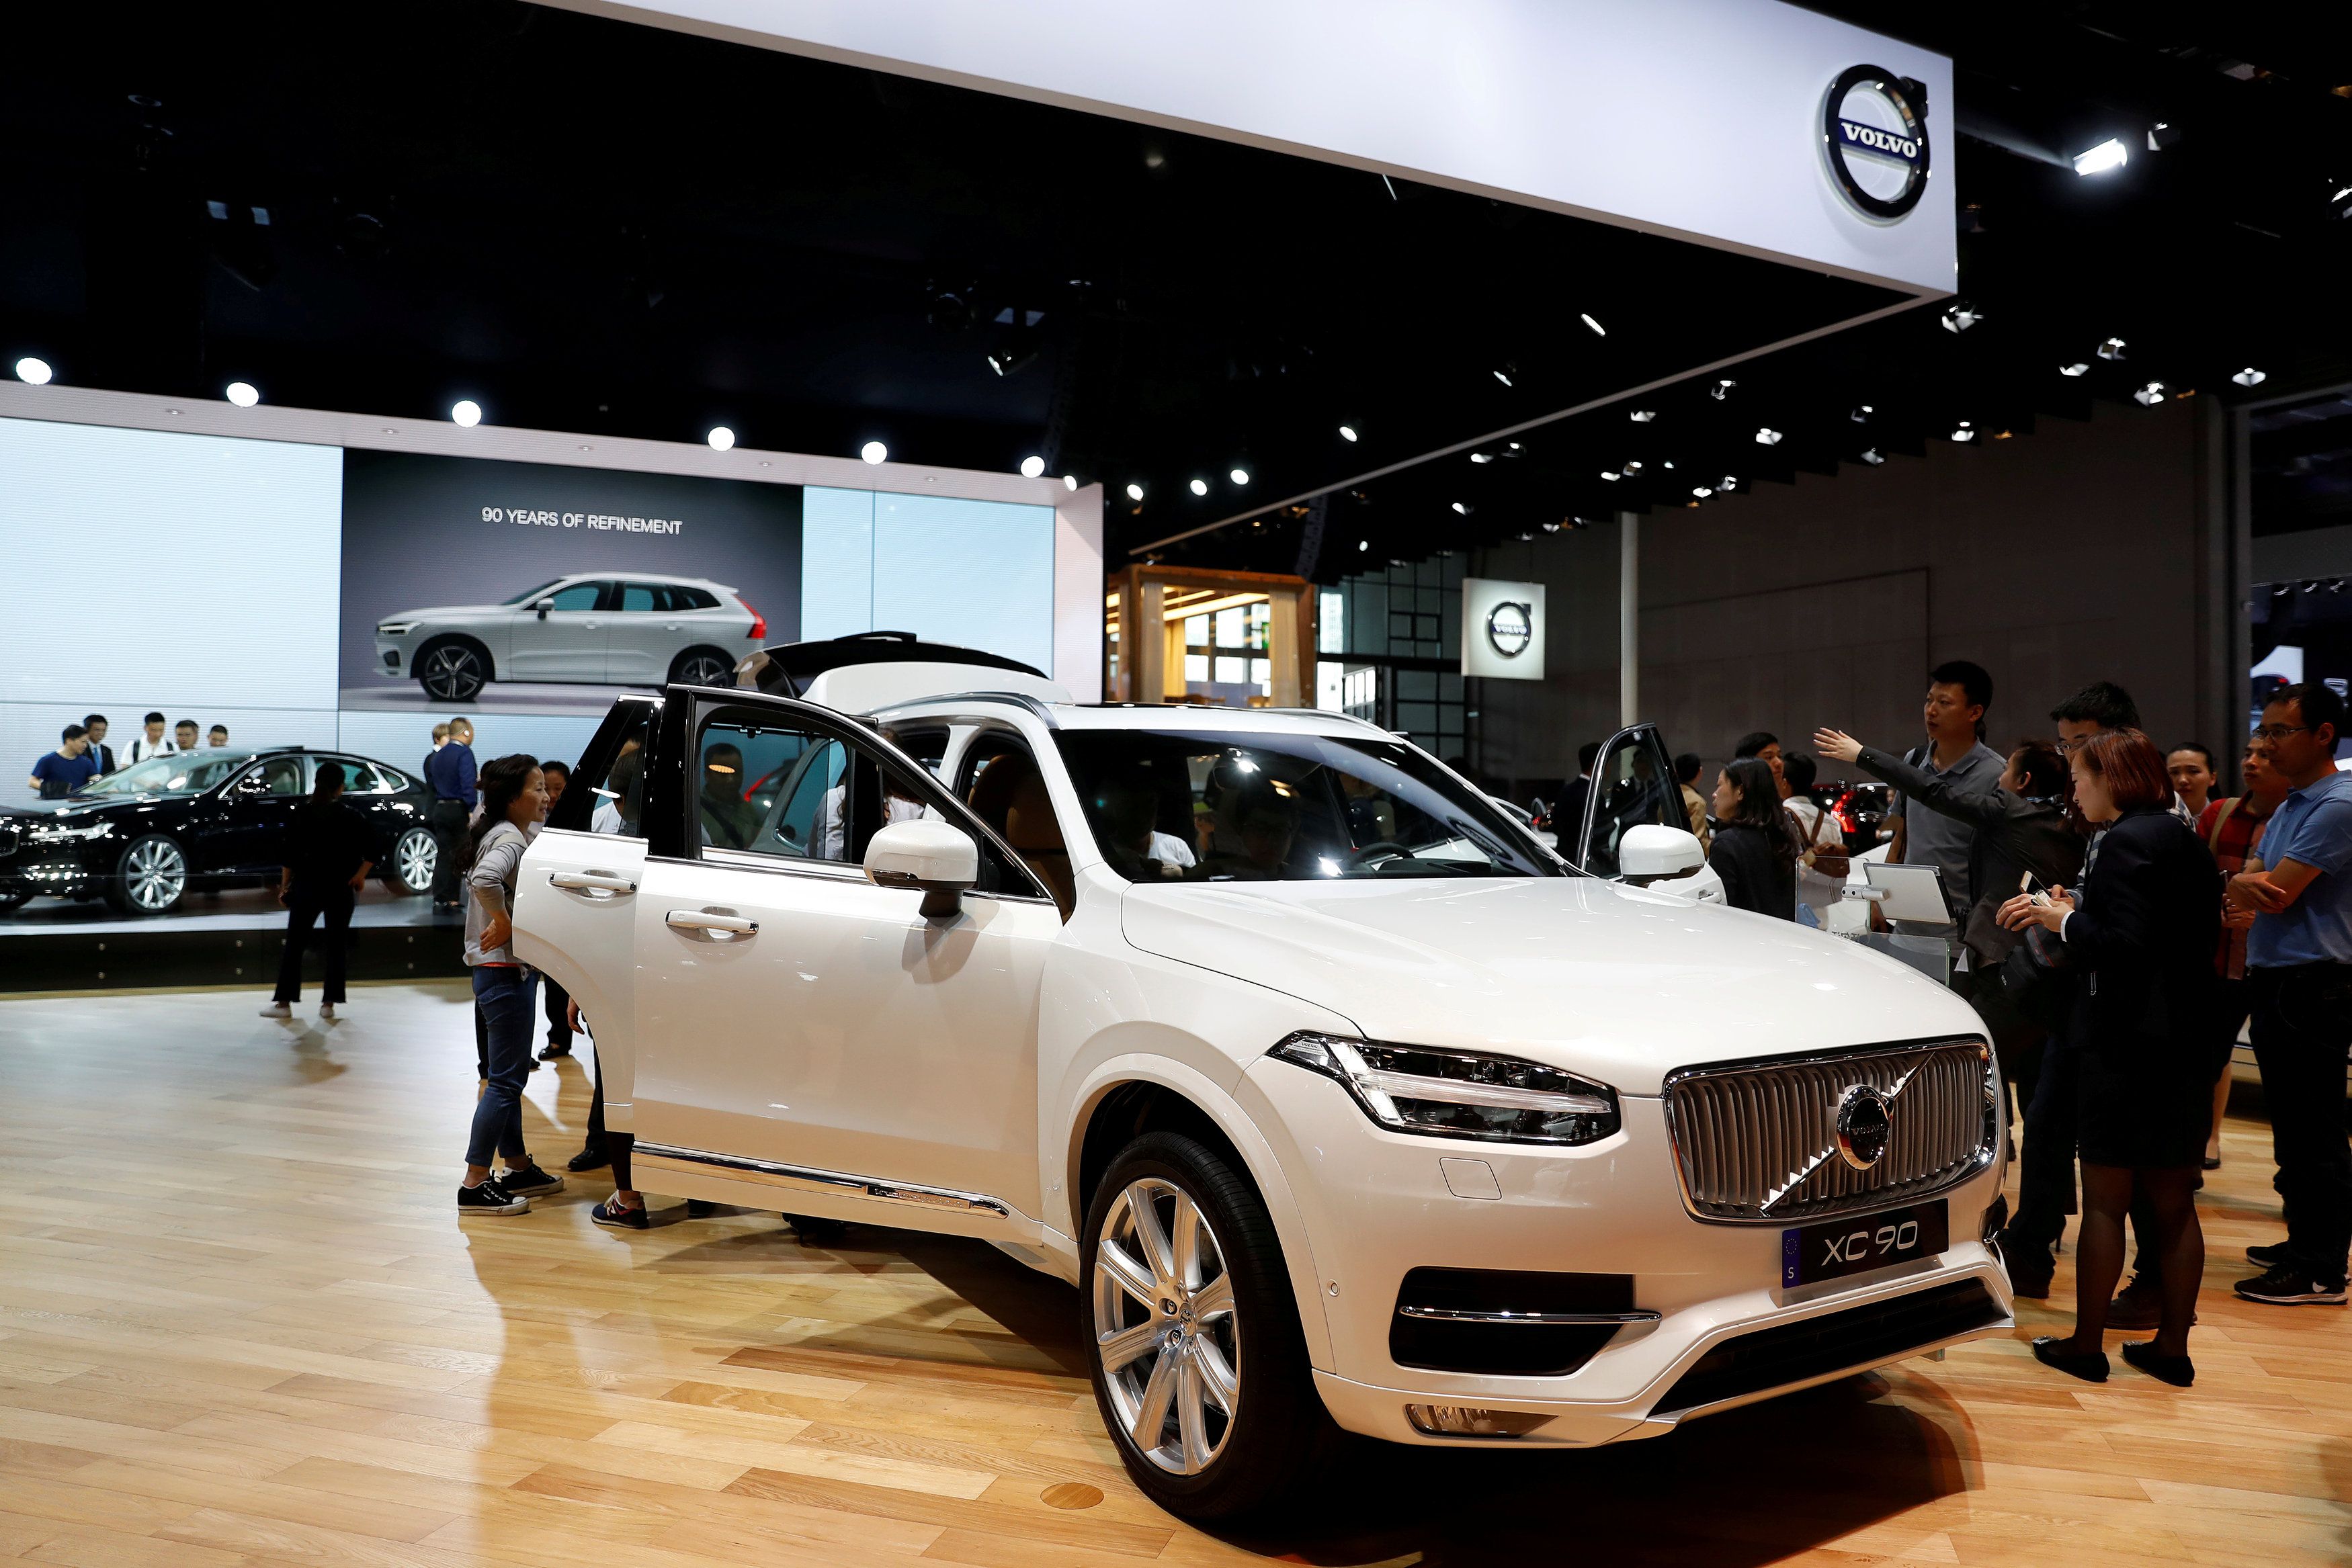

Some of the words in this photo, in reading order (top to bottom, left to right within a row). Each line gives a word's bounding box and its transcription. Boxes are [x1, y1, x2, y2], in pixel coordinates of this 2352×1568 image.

[1841, 122, 1917, 159] VOLVO
[481, 507, 503, 523] 90
[506, 509, 558, 527] YEARS
[562, 512, 585, 528] OF
[587, 514, 683, 535] REFINEMENT
[1493, 625, 1527, 635] VOLVO
[1821, 1231, 1869, 1266] XC
[1875, 1221, 1919, 1255] 90
[1788, 1266, 1794, 1279] S
